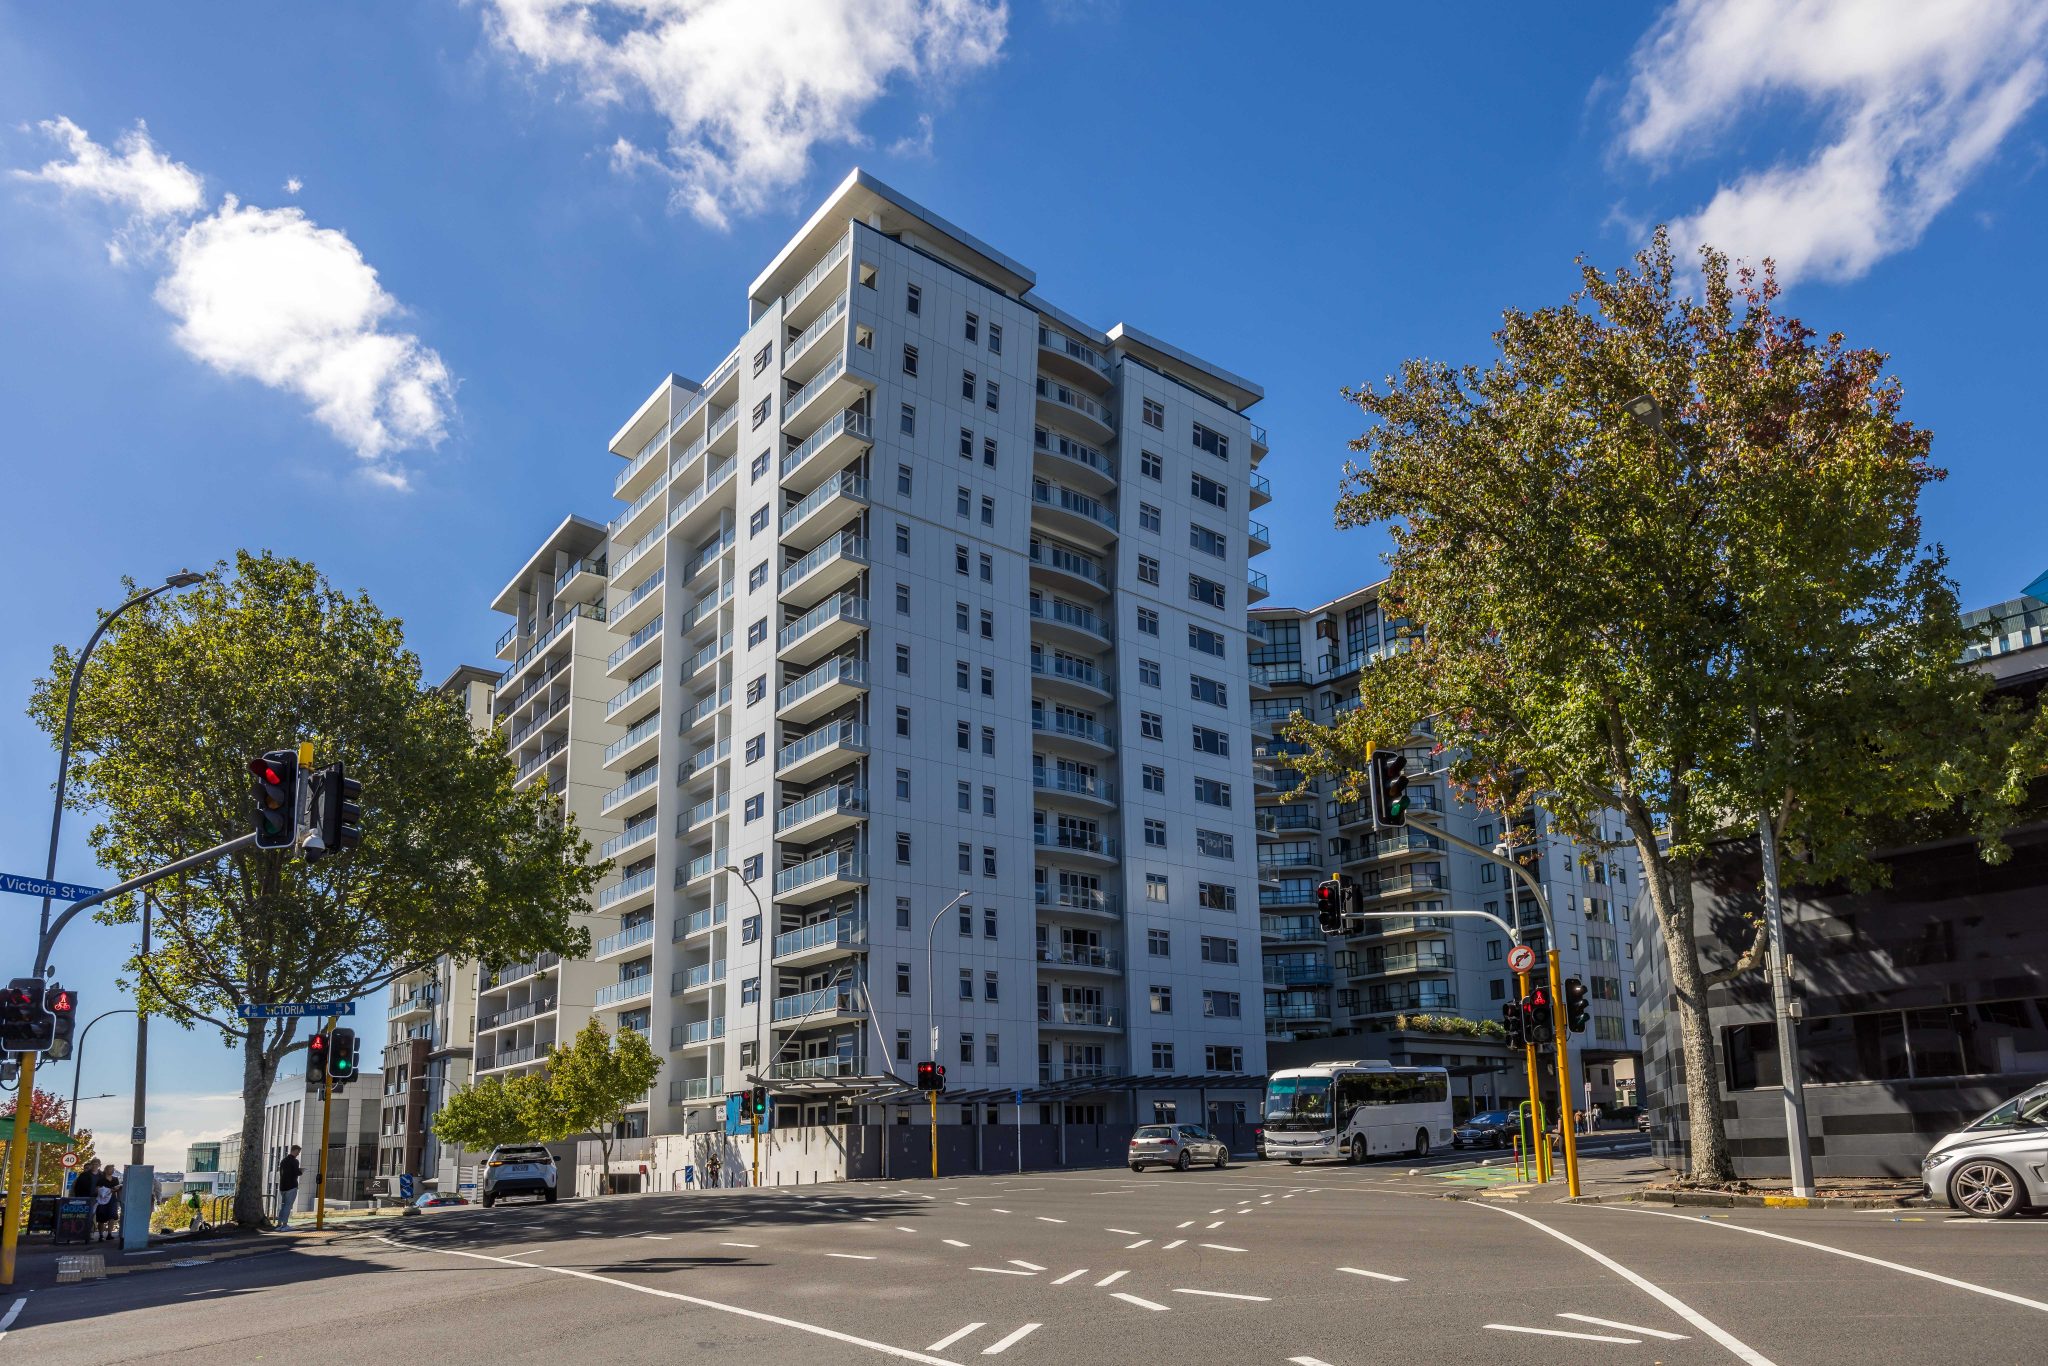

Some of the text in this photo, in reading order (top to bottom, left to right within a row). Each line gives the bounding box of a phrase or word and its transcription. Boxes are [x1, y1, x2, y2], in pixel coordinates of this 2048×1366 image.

[6, 877, 95, 899] Victoria St West
